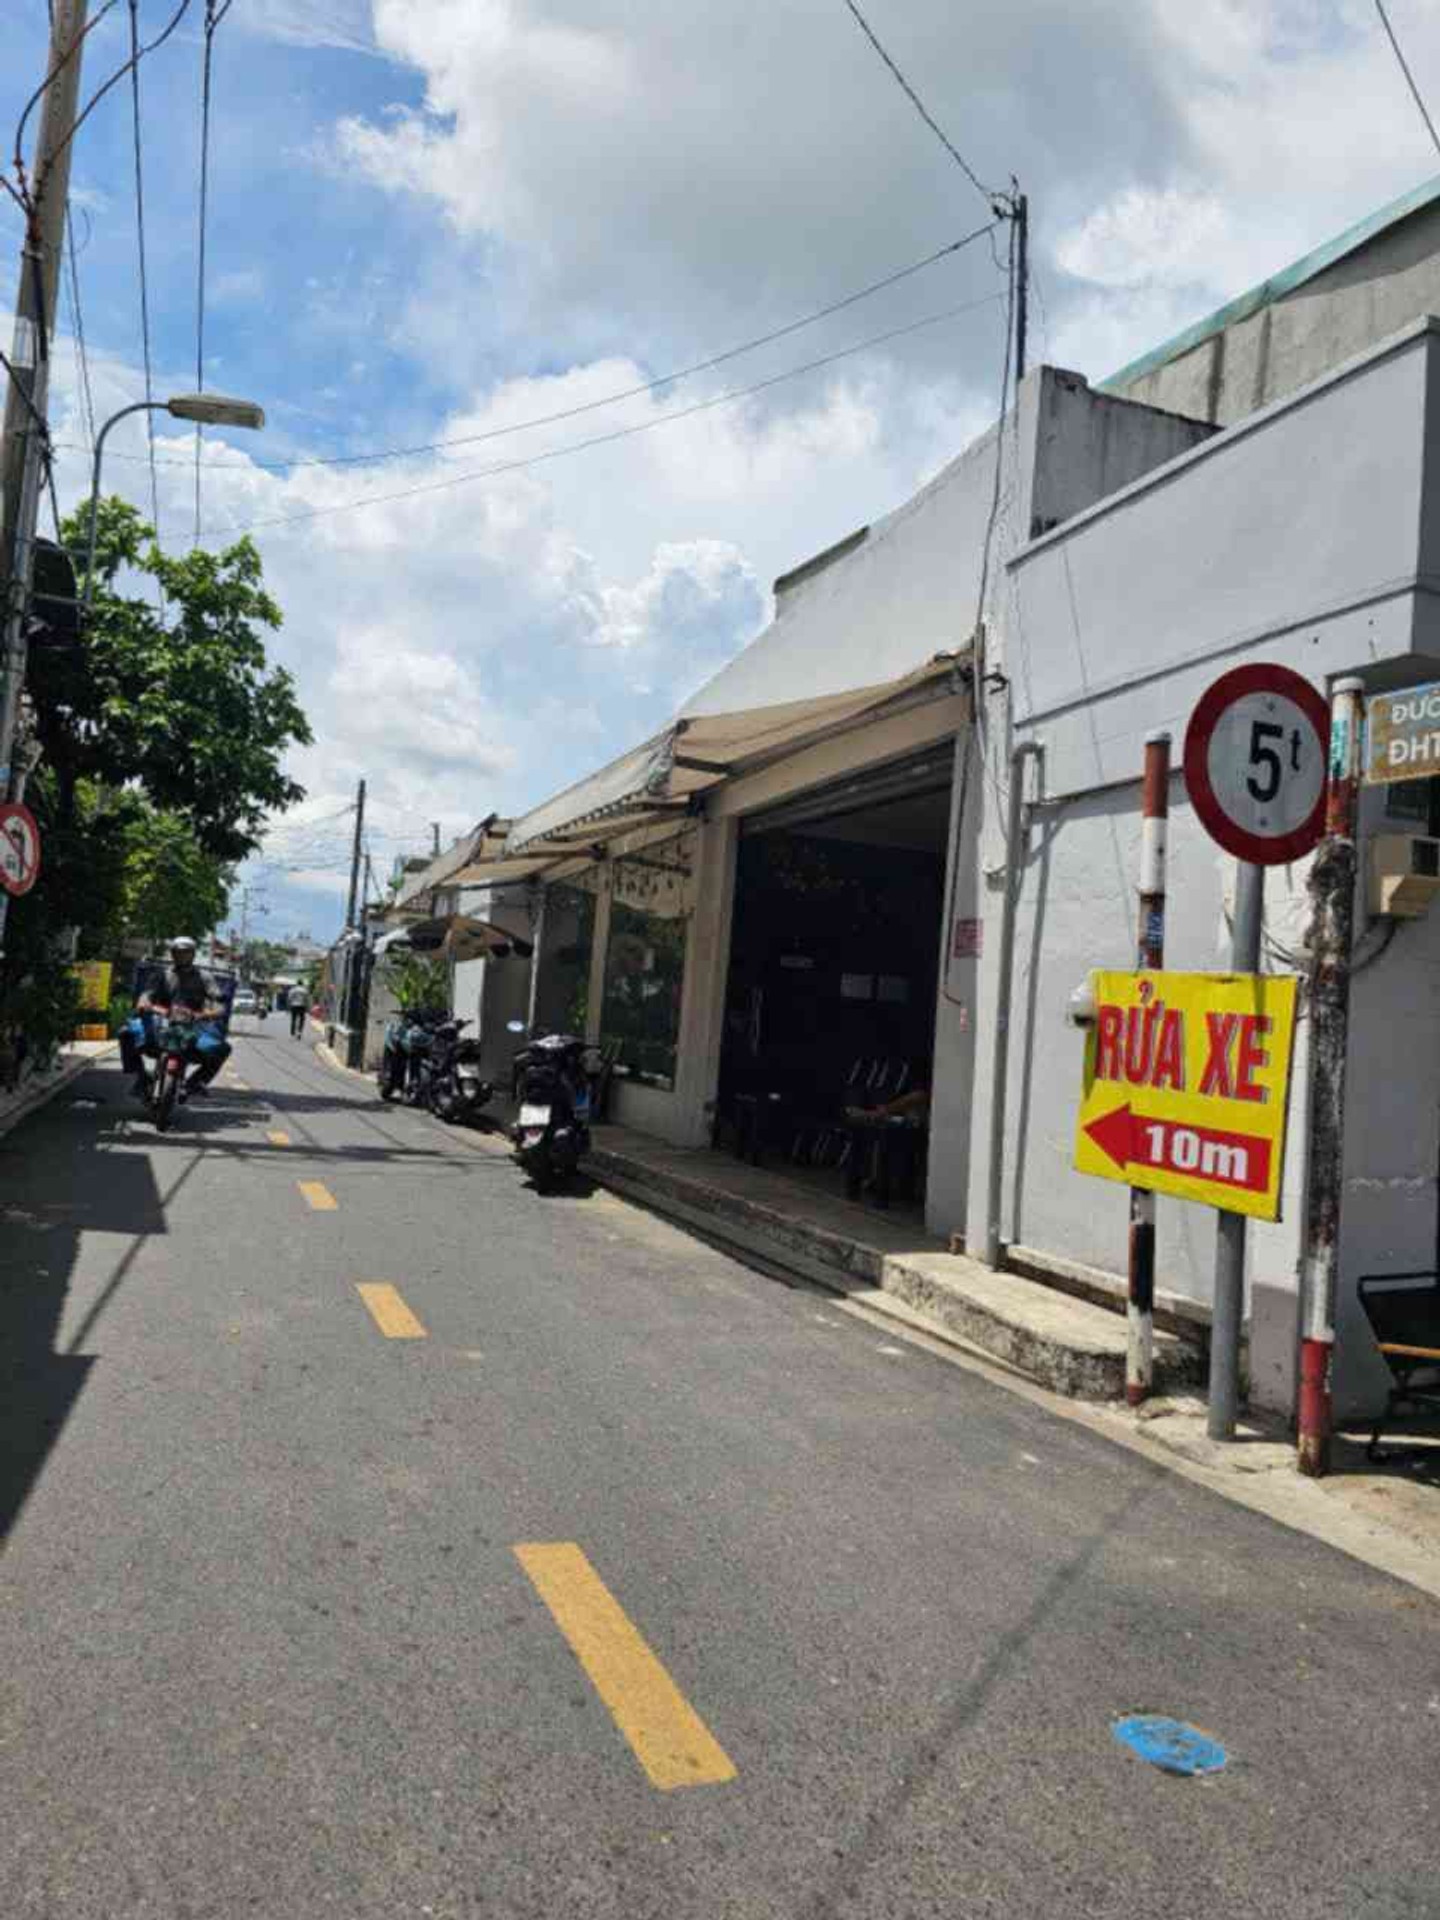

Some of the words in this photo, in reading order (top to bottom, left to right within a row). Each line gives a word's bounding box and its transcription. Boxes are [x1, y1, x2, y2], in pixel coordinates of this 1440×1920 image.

[1095, 979, 1184, 1091] RỬA
[1198, 1012, 1271, 1104] XE
[1146, 1124, 1248, 1181] 10m
